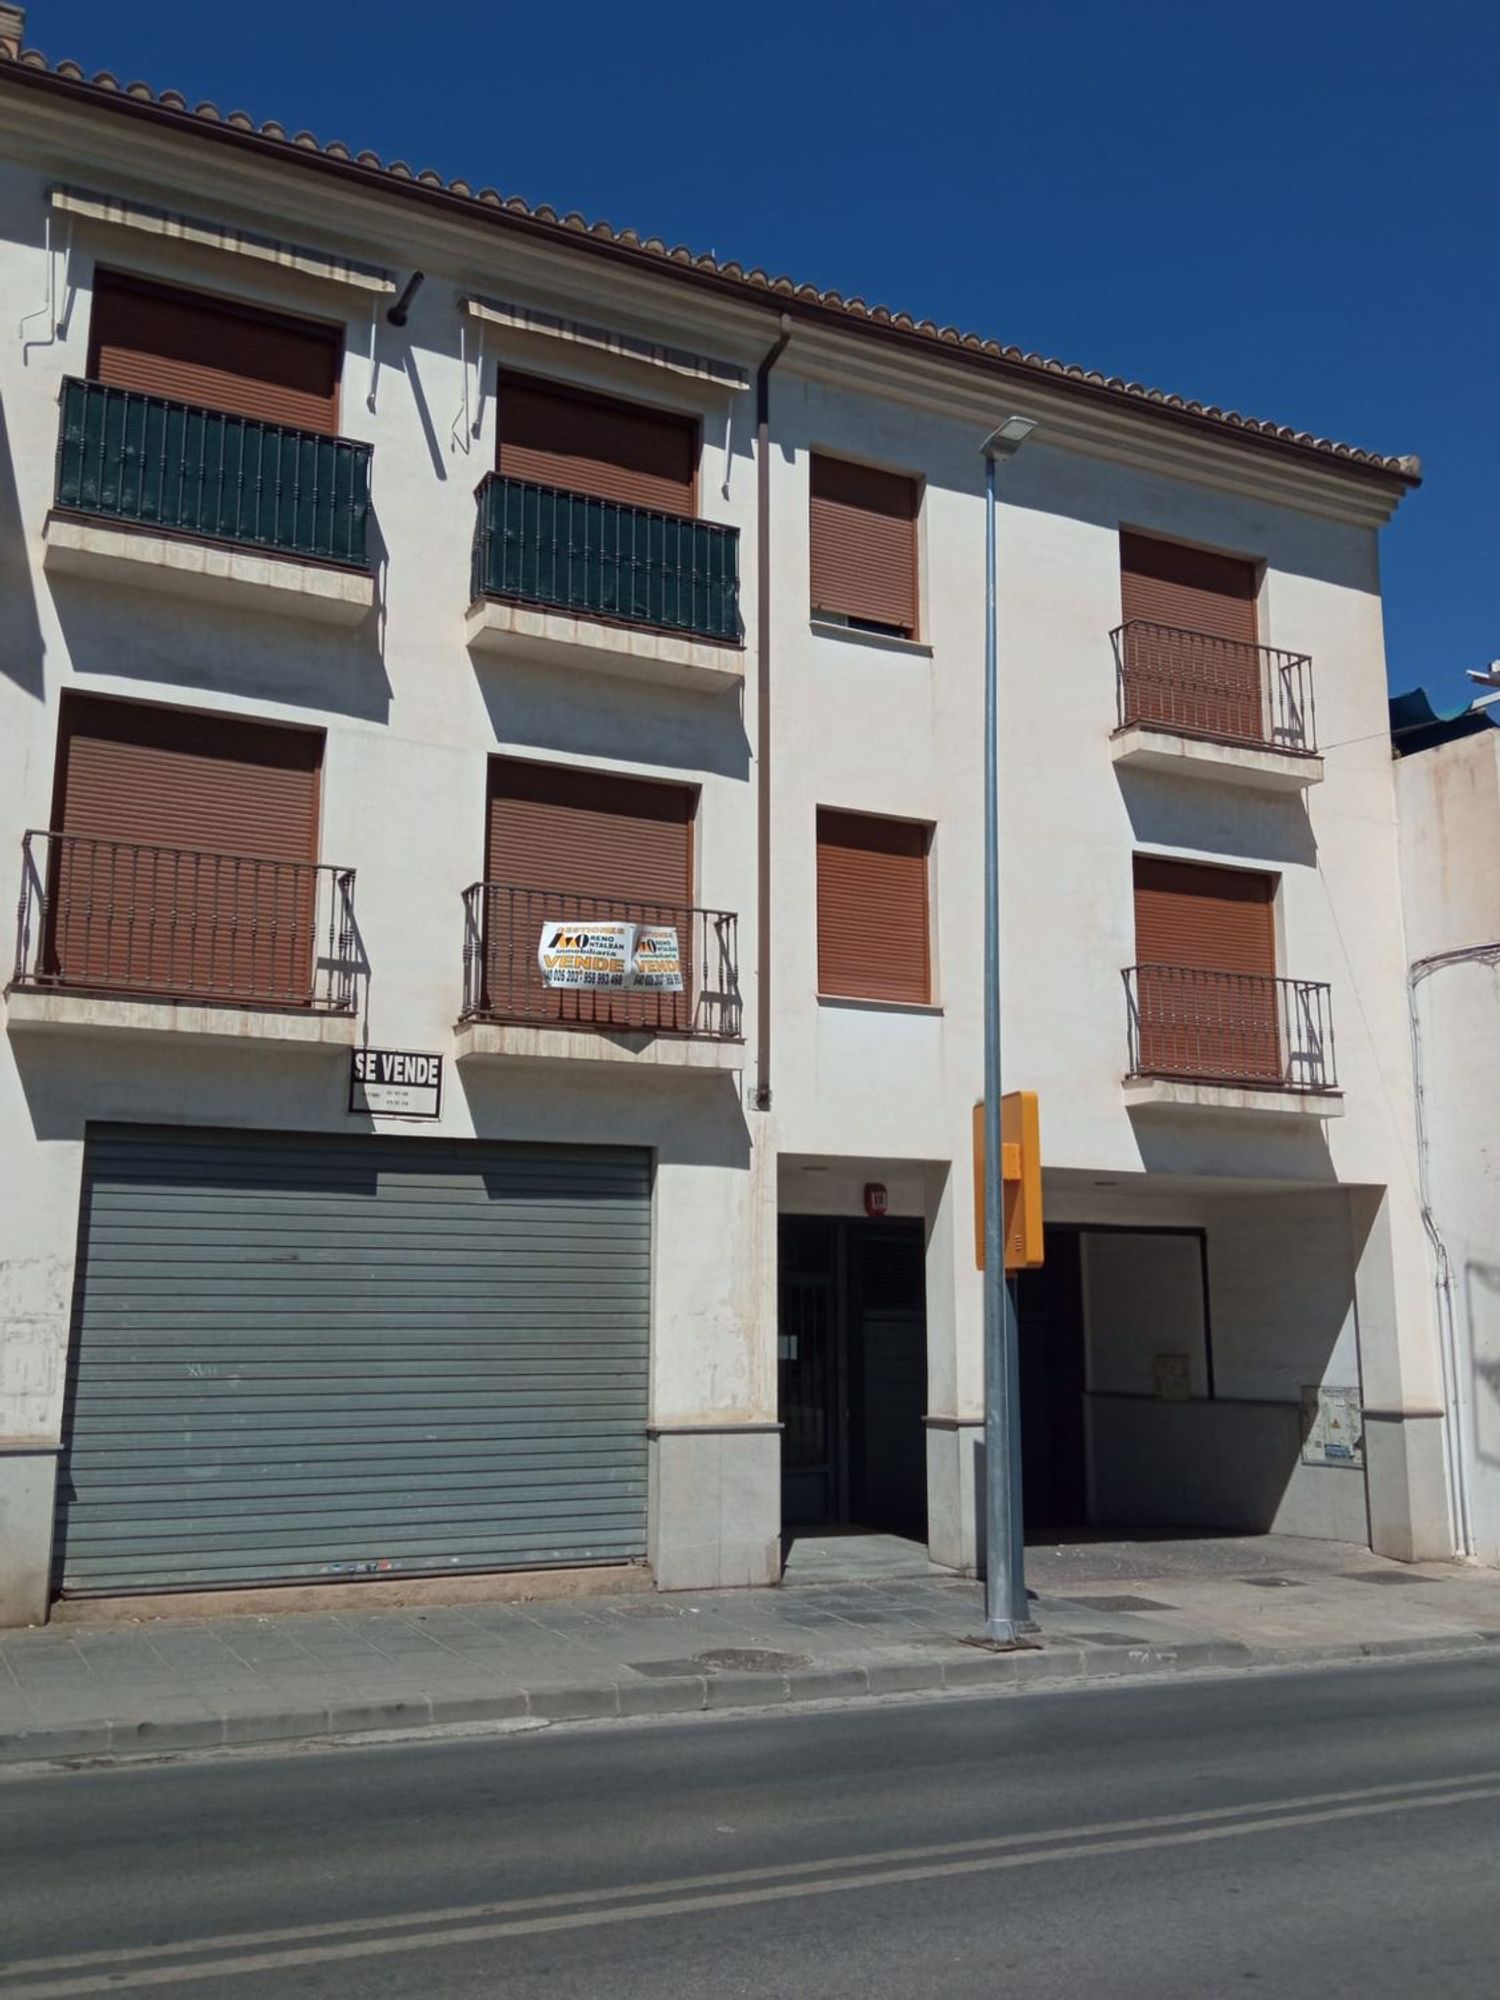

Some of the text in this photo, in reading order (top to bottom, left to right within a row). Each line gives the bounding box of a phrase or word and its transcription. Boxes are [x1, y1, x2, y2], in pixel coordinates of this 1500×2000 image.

[556, 948, 617, 957] inmobiliaria
[543, 955, 625, 973] VENDE
[355, 1053, 439, 1085] SE VENDE
